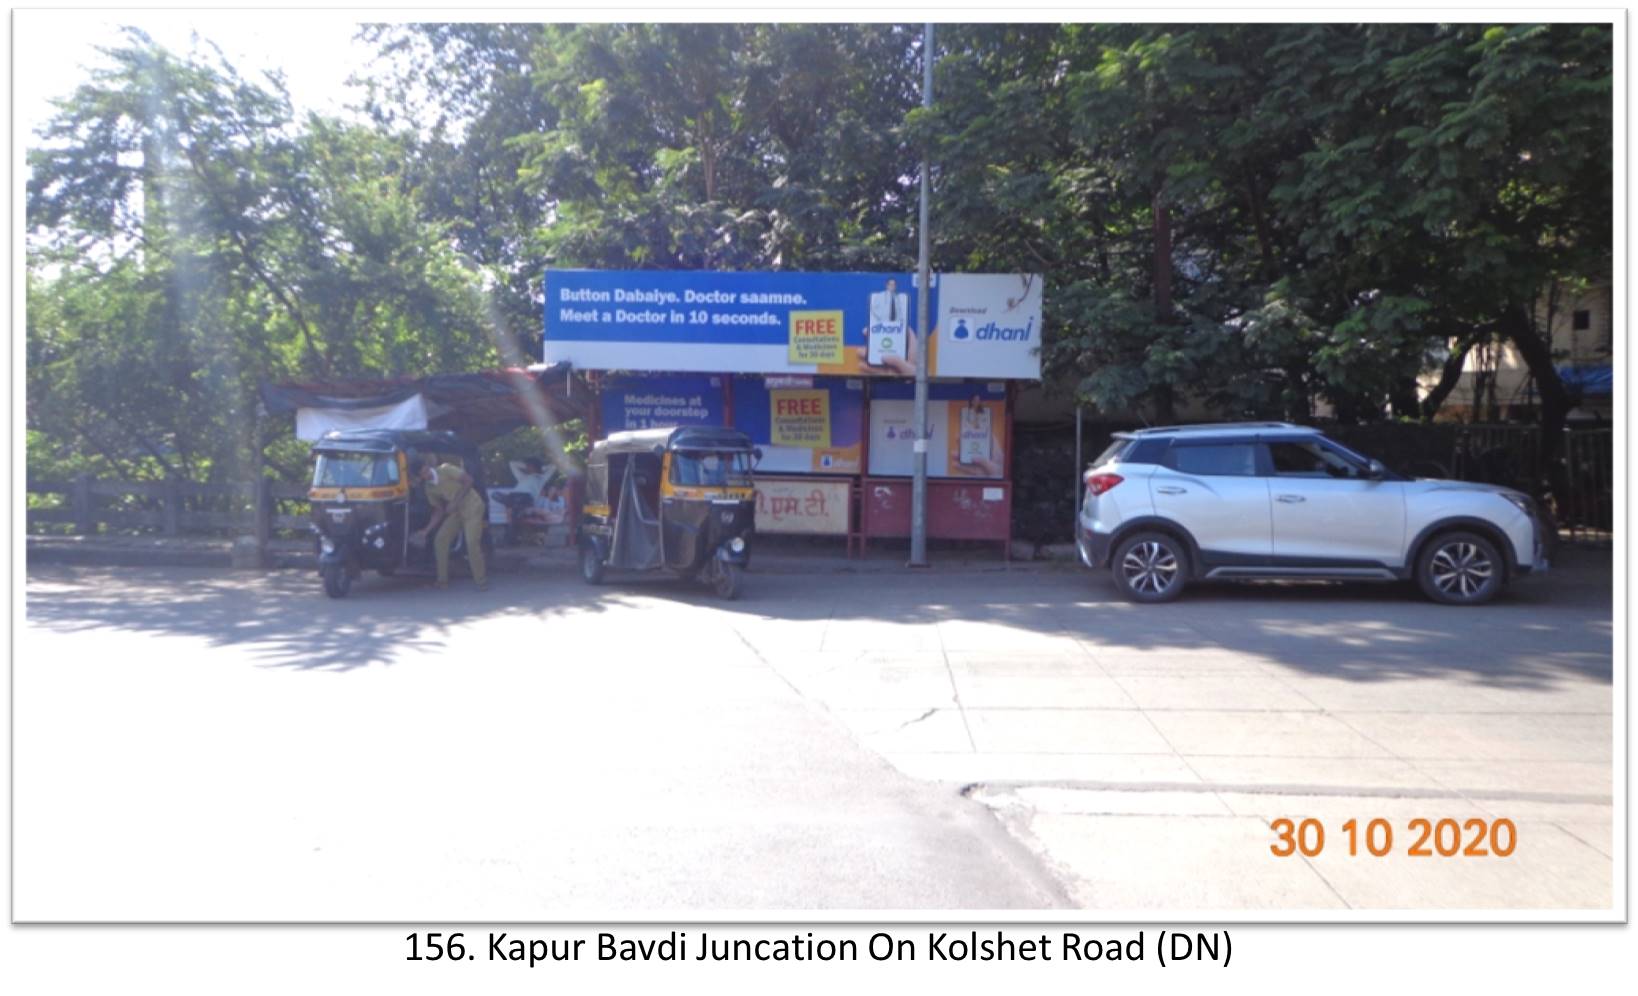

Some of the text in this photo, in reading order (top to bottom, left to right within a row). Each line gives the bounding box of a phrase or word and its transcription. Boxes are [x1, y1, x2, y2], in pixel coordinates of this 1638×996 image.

[560, 288, 807, 305] Button Dabaiye. Doctor saamne.
[560, 309, 781, 325] Meet a Doctor in 10 seconds.
[795, 319, 836, 335] FREE
[976, 316, 1034, 341] dhani
[624, 394, 702, 406] Medicines at
[777, 399, 822, 415] FREE
[624, 406, 709, 419] your doorstep
[625, 417, 637, 429] in
